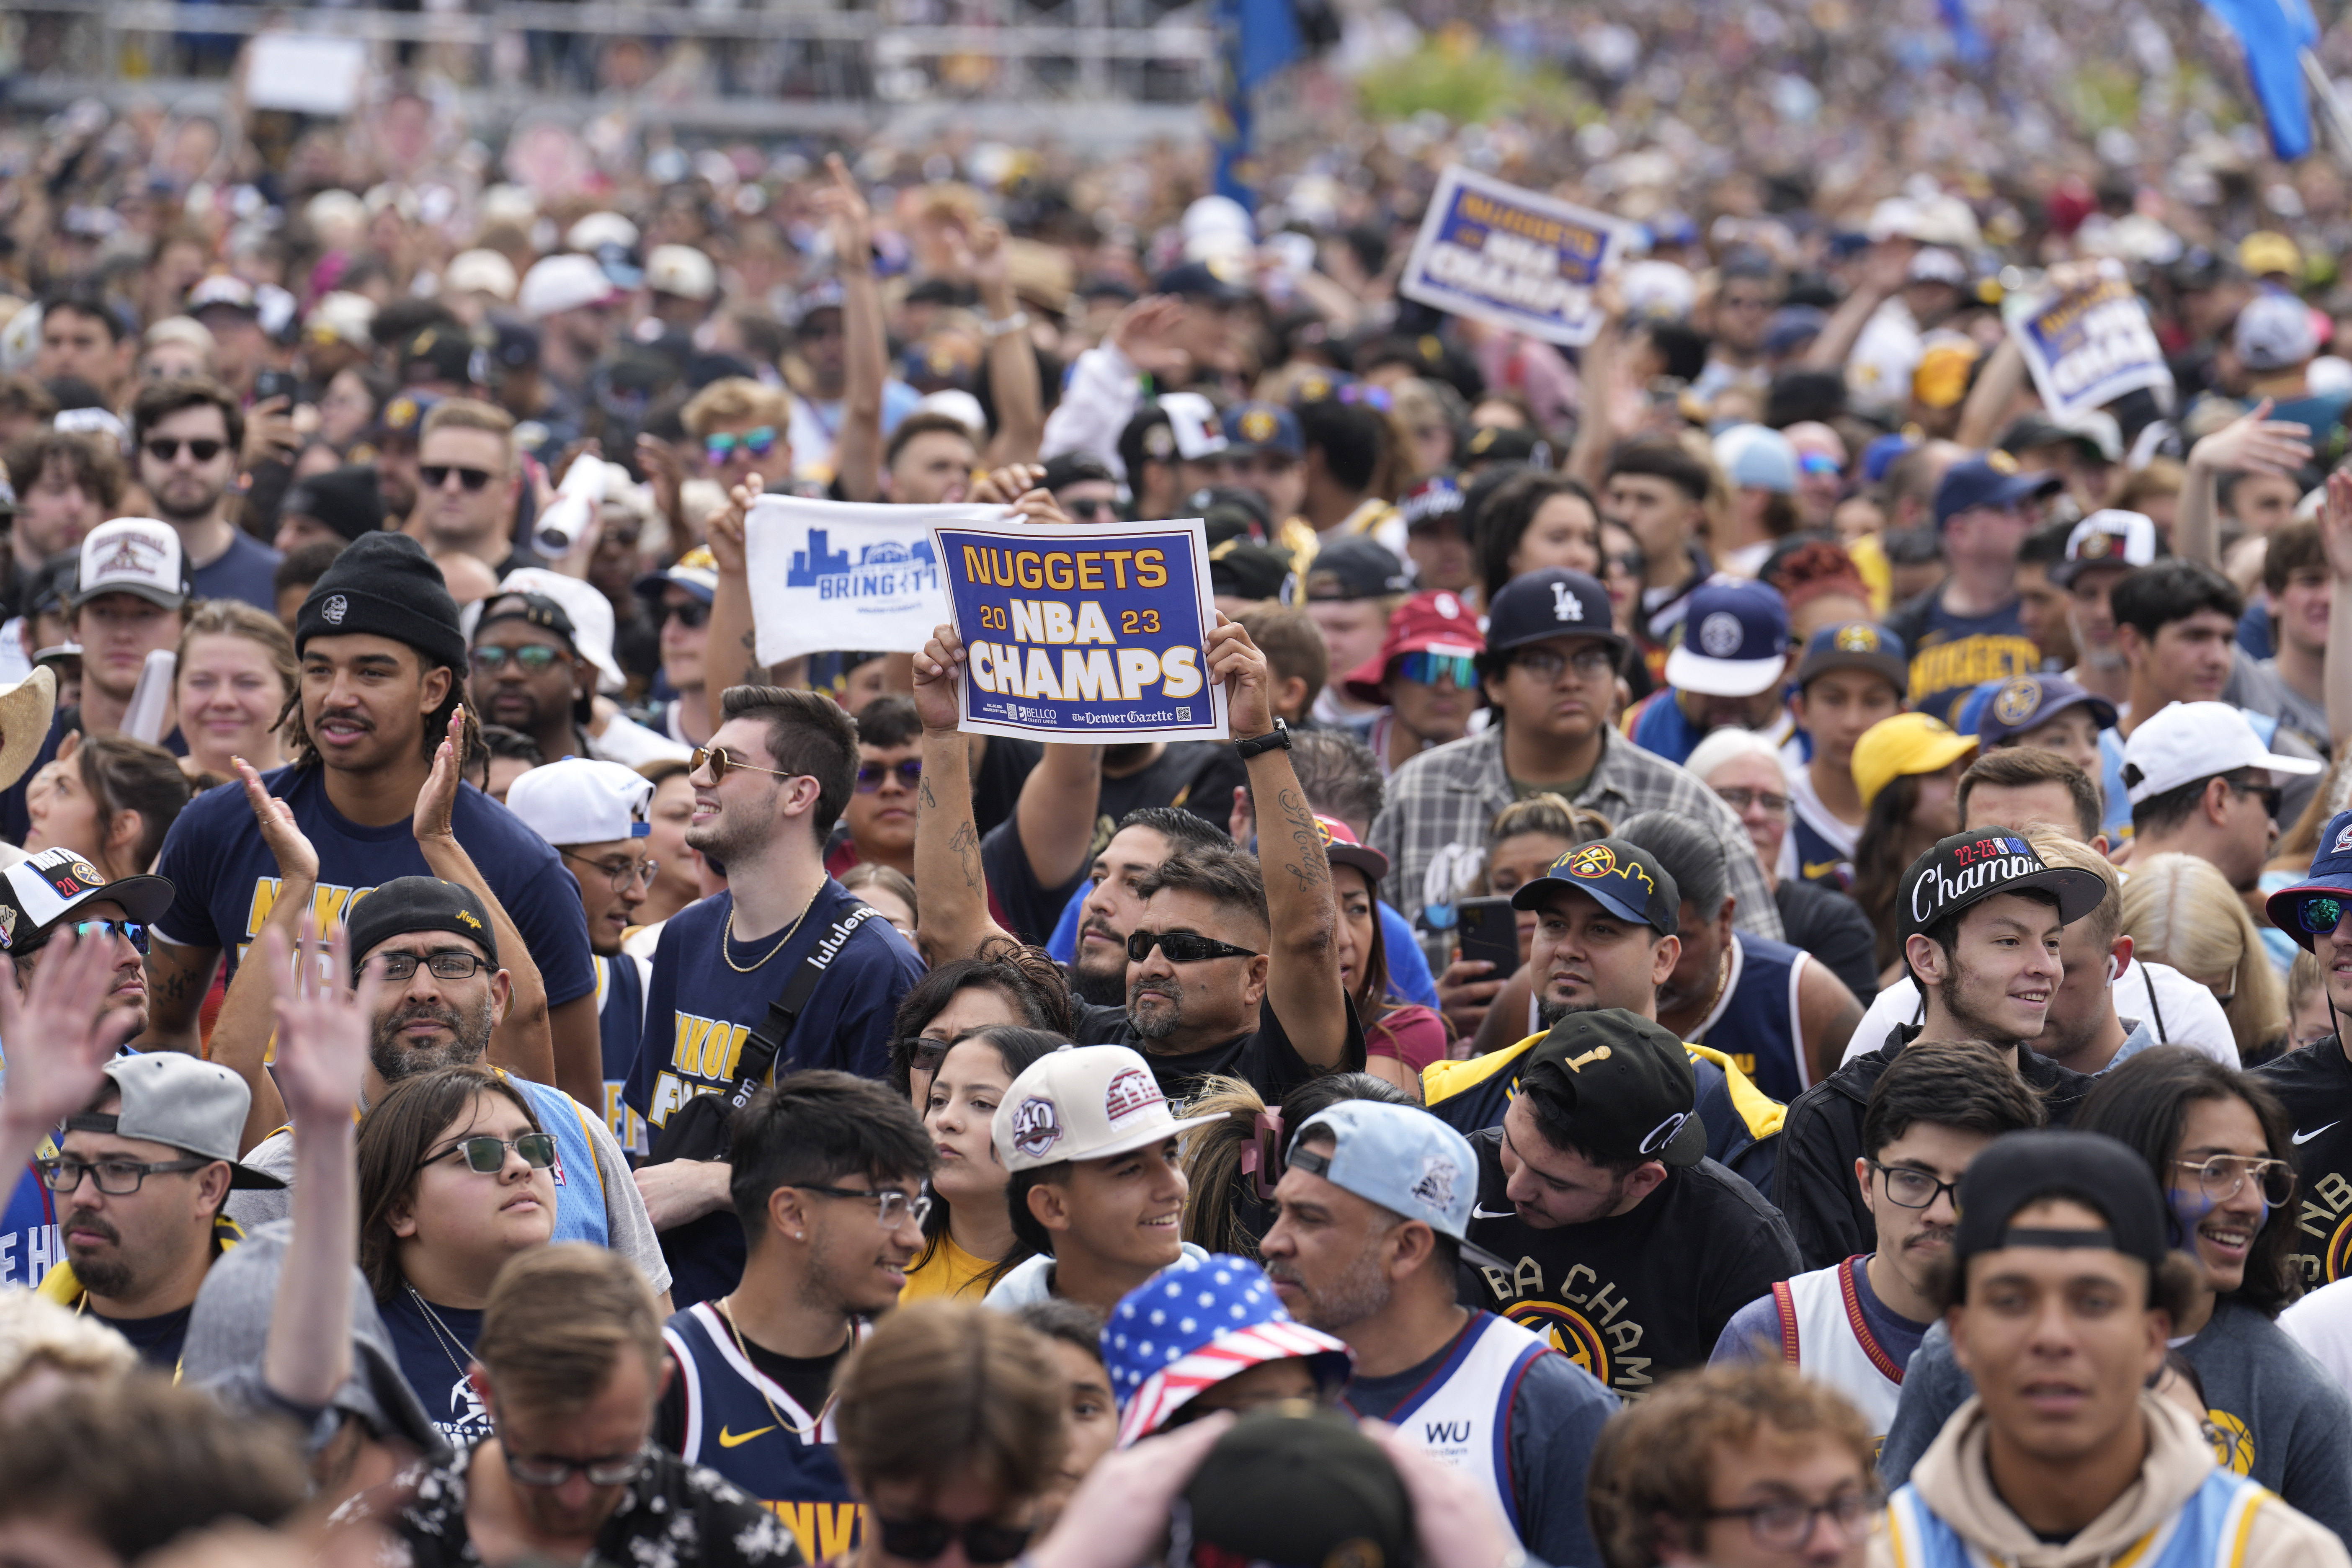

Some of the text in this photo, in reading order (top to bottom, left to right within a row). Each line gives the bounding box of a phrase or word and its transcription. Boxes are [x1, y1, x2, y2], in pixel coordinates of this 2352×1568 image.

[962, 544, 1168, 591] NUGGETS
[820, 575, 894, 600] BRING
[980, 598, 1161, 645] 20 NBA 23
[968, 640, 1203, 701] CHAMPS
[1026, 707, 1057, 719] BELLCO
[1072, 710, 1173, 725] The Denver Gazette
[28, 850, 67, 872] NBA
[1954, 837, 2030, 867] 22-23 NBA
[56, 877, 80, 896] 20
[455, 909, 482, 929] Nugs
[1015, 1103, 1054, 1134] 40
[1480, 1256, 1544, 1301] BA
[1426, 1421, 1471, 1443] WU
